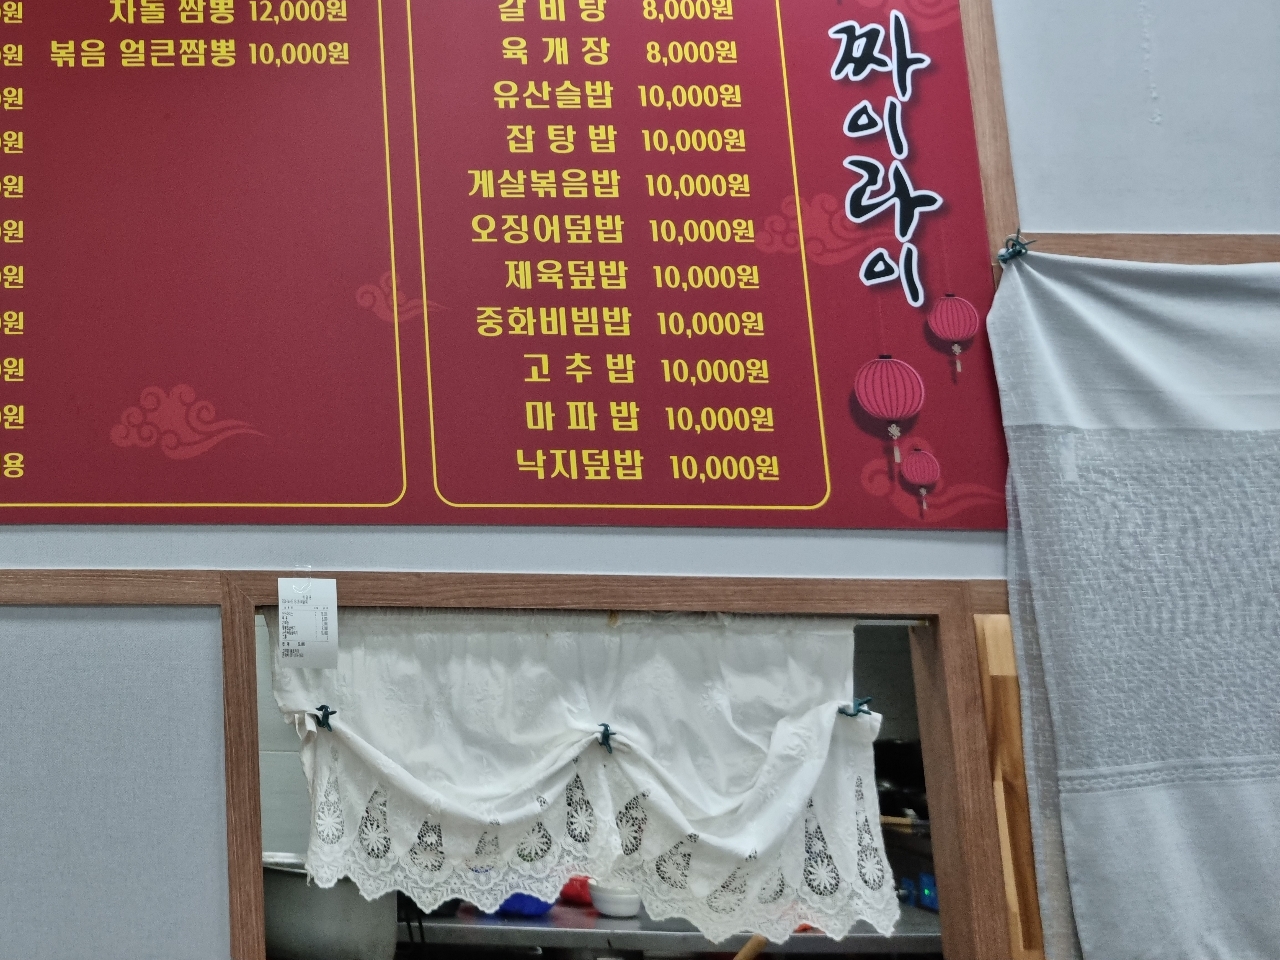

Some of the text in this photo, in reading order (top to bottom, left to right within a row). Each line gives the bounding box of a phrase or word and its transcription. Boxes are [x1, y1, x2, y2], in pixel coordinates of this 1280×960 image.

[50, 38, 350, 68] 볶음 얼큰짬뽕 10,000원
[646, 39, 738, 67] 8,000원
[493, 79, 742, 111] 유산슬밥 10,000원
[641, 128, 747, 155] 10,000원
[467, 168, 751, 200] 게살볶음밥 10,000원
[471, 214, 756, 246] 오징어덮밥 10,000원
[504, 259, 760, 292] 제육덮밥 10,000원
[476, 306, 765, 339] 중화비빔밥 10,000원
[660, 358, 770, 387] 10,000원
[664, 406, 775, 435] 10,000원
[516, 449, 780, 484] 낙지덮밥 10,000원
